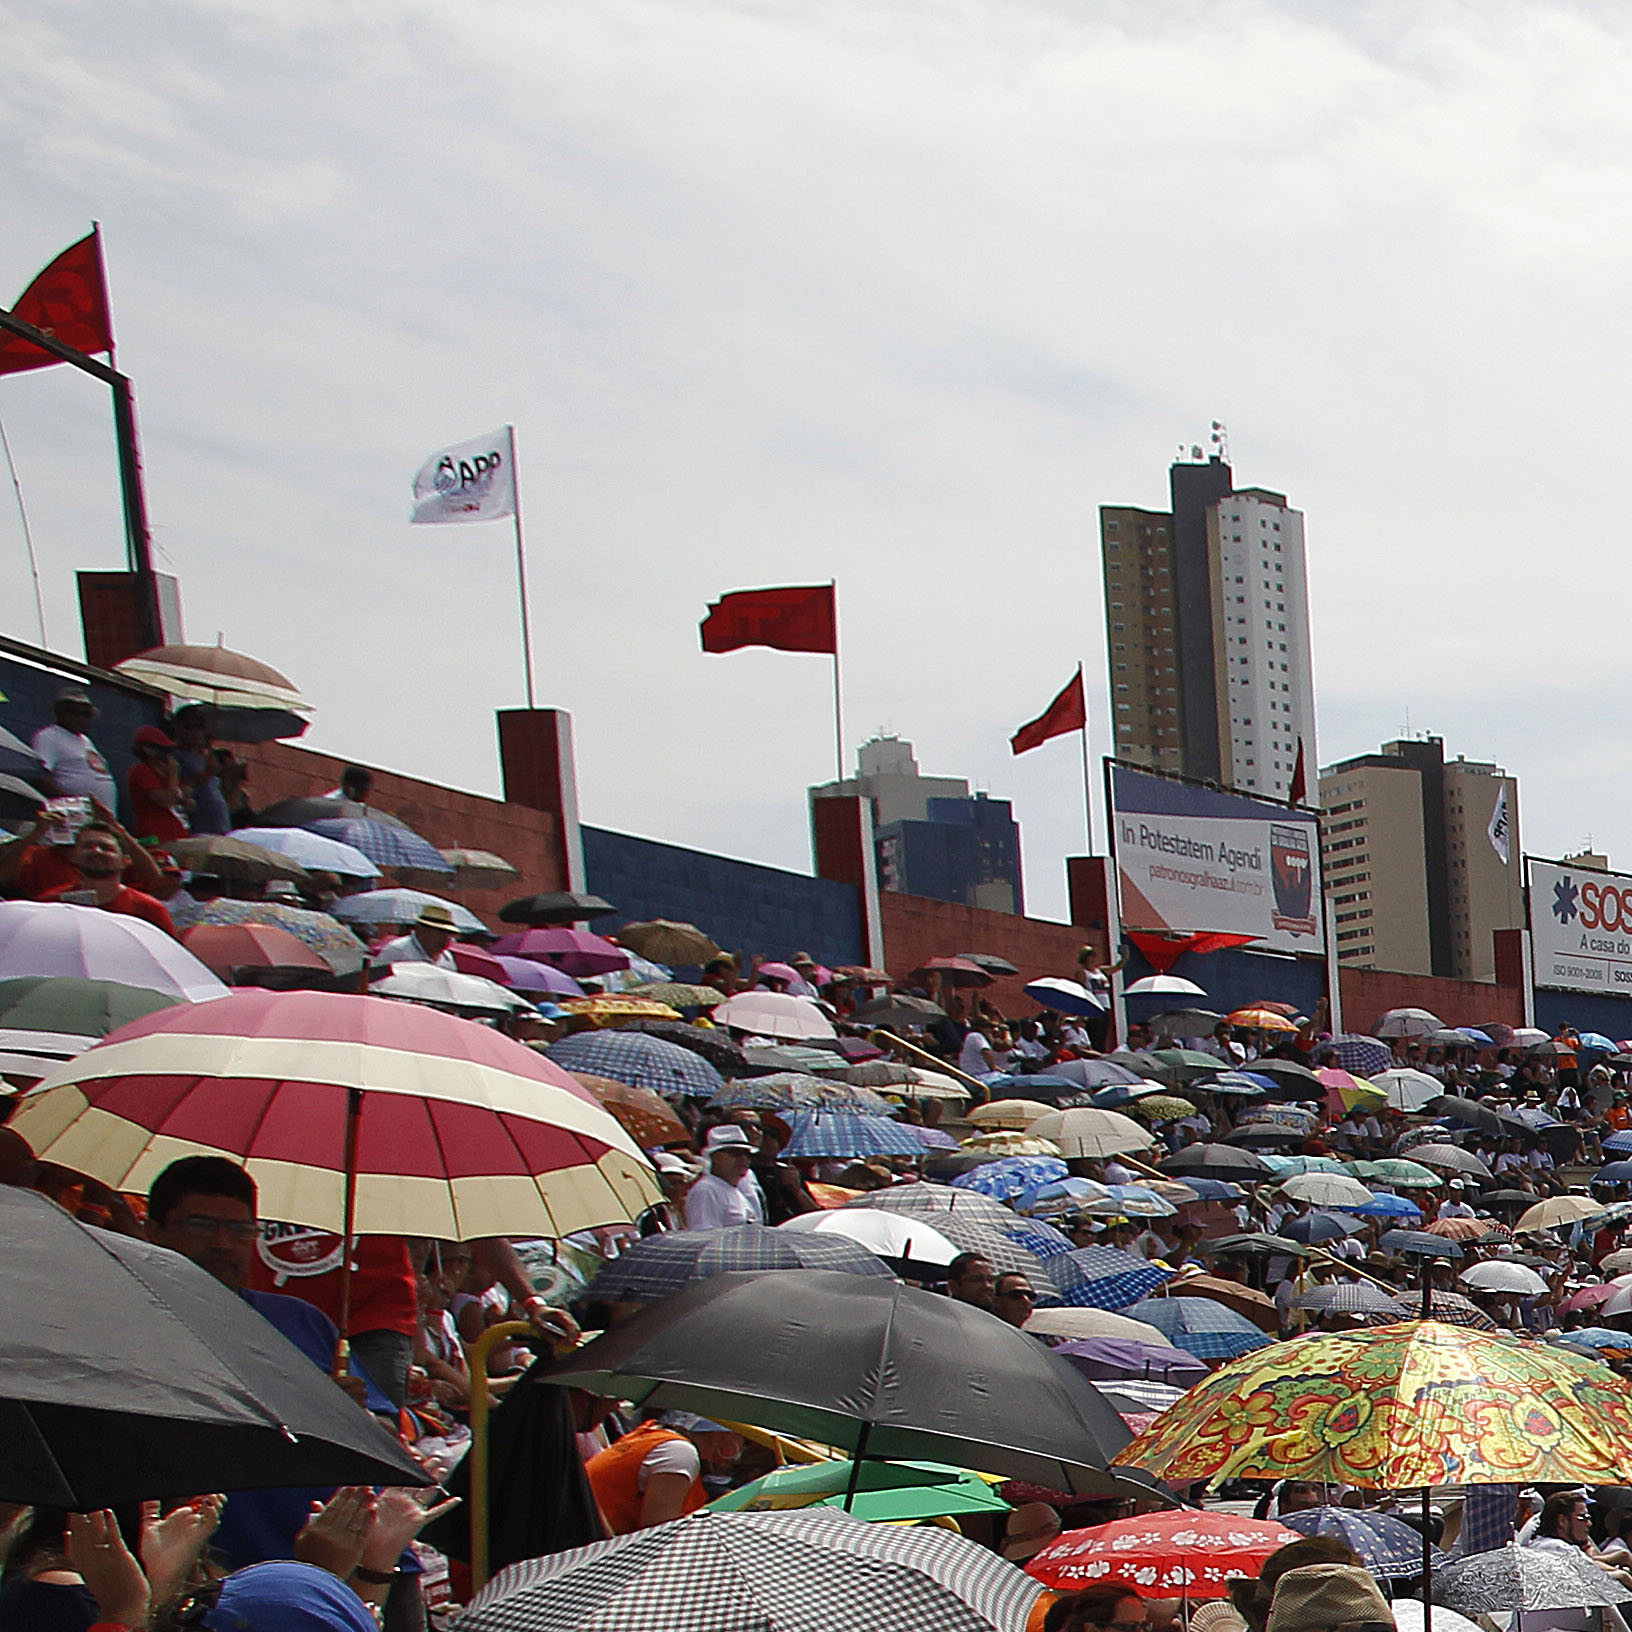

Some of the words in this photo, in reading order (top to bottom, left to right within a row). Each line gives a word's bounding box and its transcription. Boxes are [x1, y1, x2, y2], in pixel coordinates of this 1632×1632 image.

[1121, 820, 1136, 845] In
[1140, 824, 1214, 862] Potestatem
[1218, 842, 1262, 872] Agendi
[1580, 934, 1588, 949] A
[1590, 938, 1615, 951] casa
[1617, 940, 1630, 955] do
[1553, 964, 1566, 976] ISO
